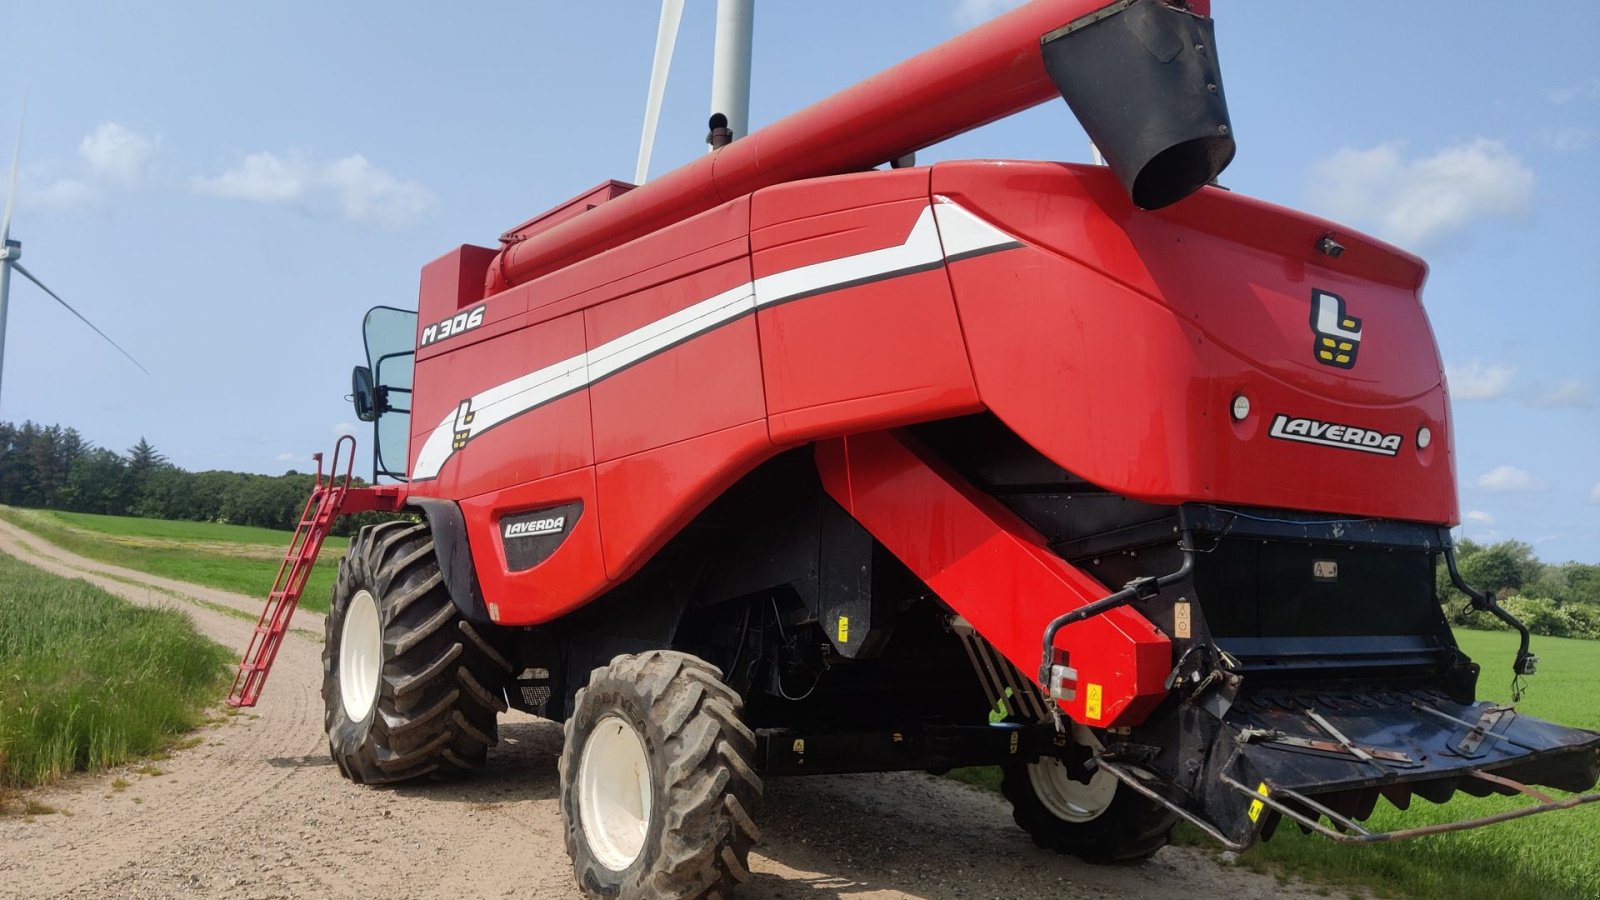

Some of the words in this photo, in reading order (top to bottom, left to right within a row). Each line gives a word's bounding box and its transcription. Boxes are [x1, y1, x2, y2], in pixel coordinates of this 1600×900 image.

[421, 325, 438, 346] M
[437, 306, 486, 340] 306
[1270, 414, 1401, 455] LAVERDA
[504, 516, 565, 539] LAVERDA
